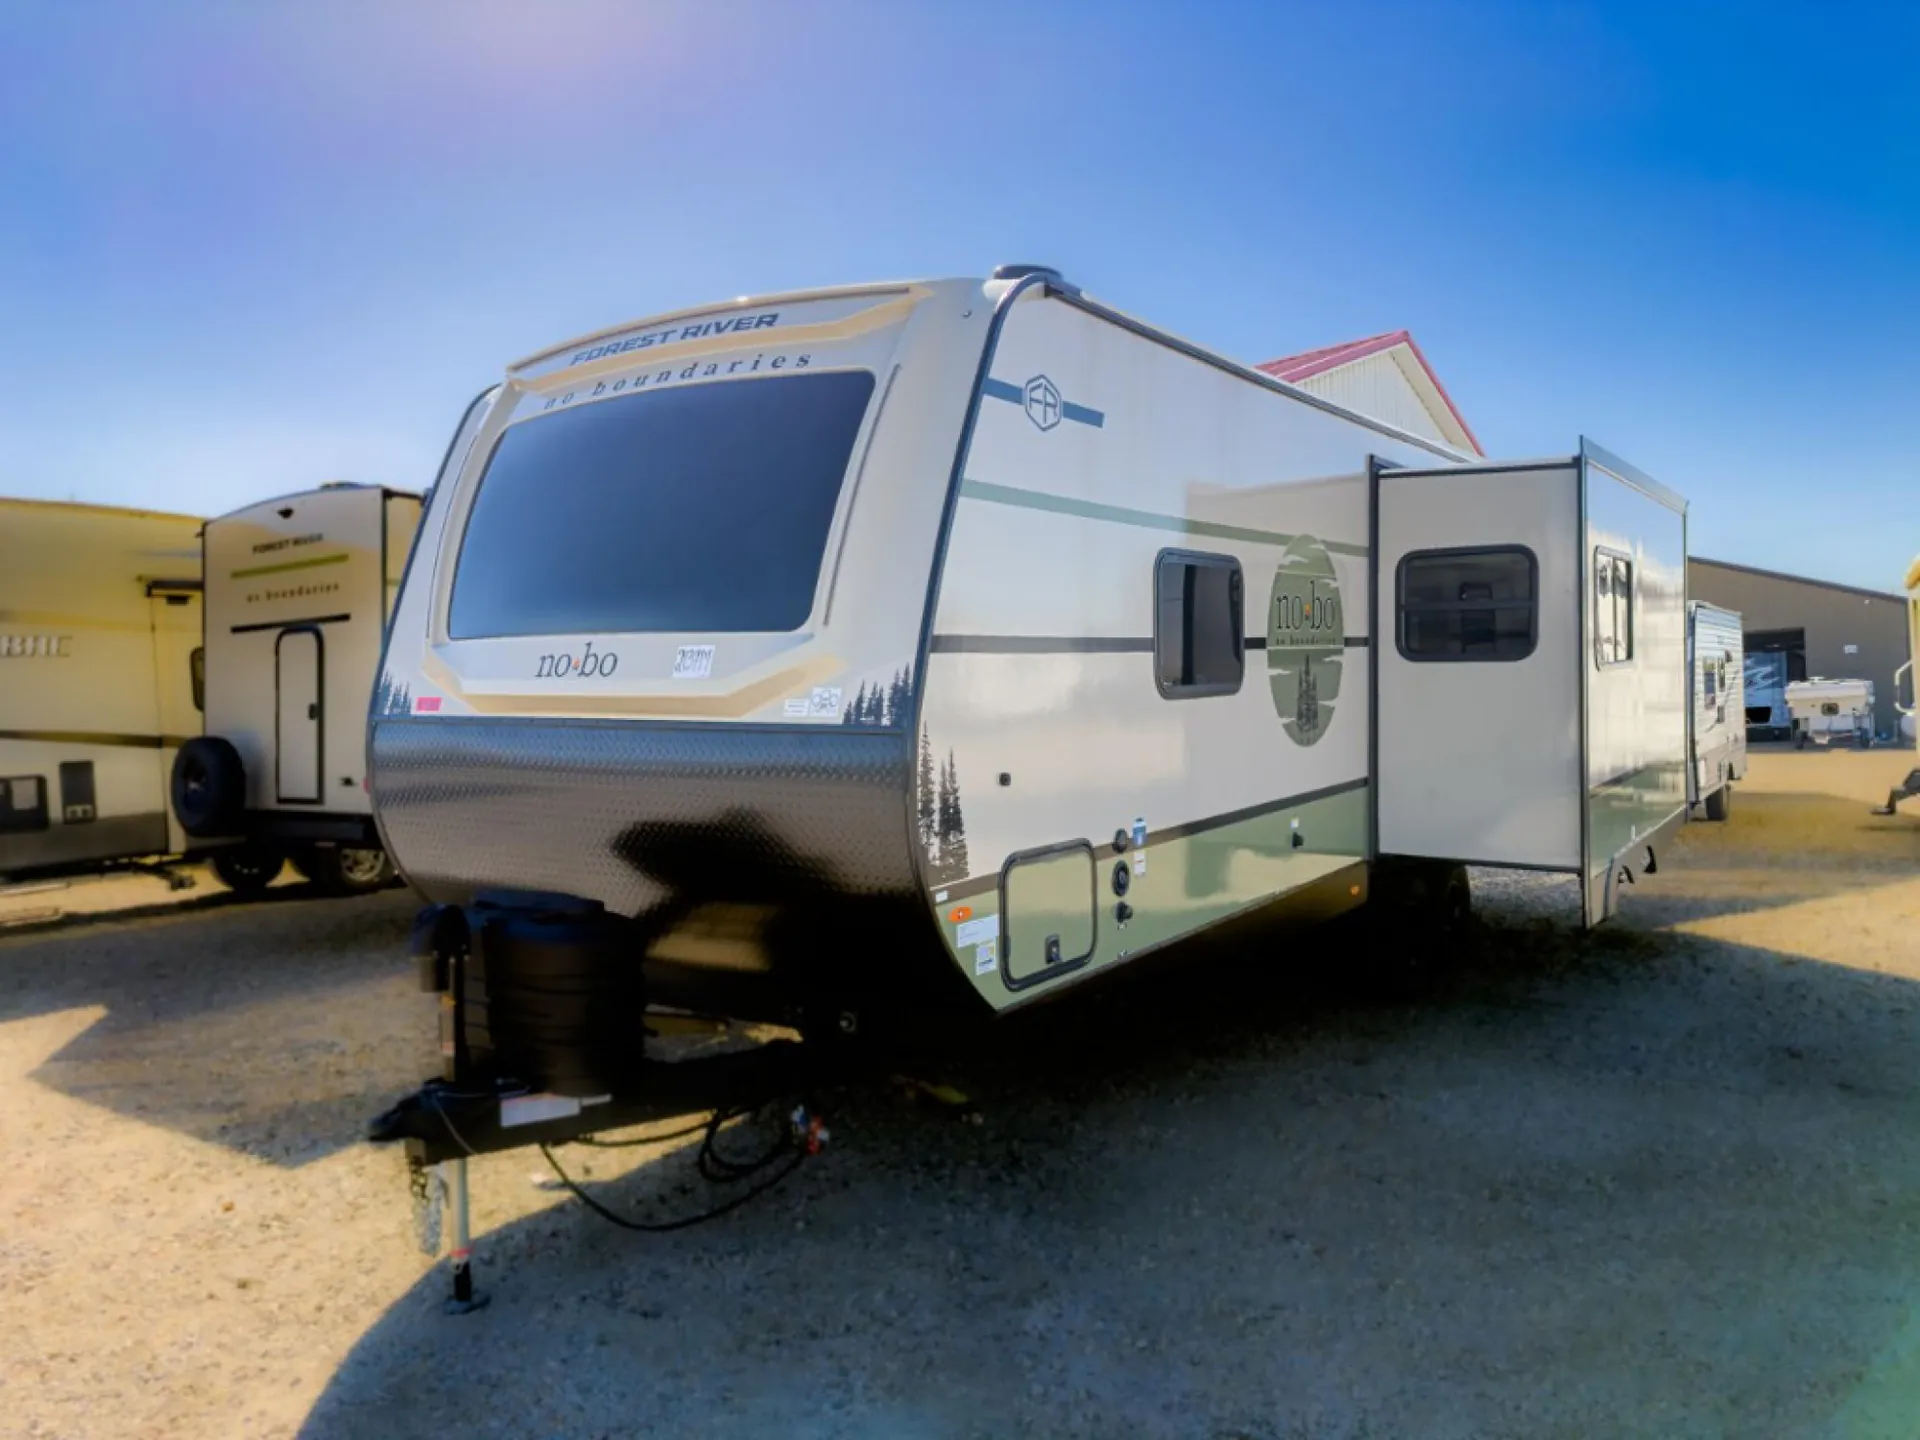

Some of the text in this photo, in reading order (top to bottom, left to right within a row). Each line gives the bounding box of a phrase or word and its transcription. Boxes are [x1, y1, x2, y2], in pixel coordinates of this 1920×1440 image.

[570, 312, 780, 366] FOREST RIVER
[544, 353, 811, 410] no boundaries
